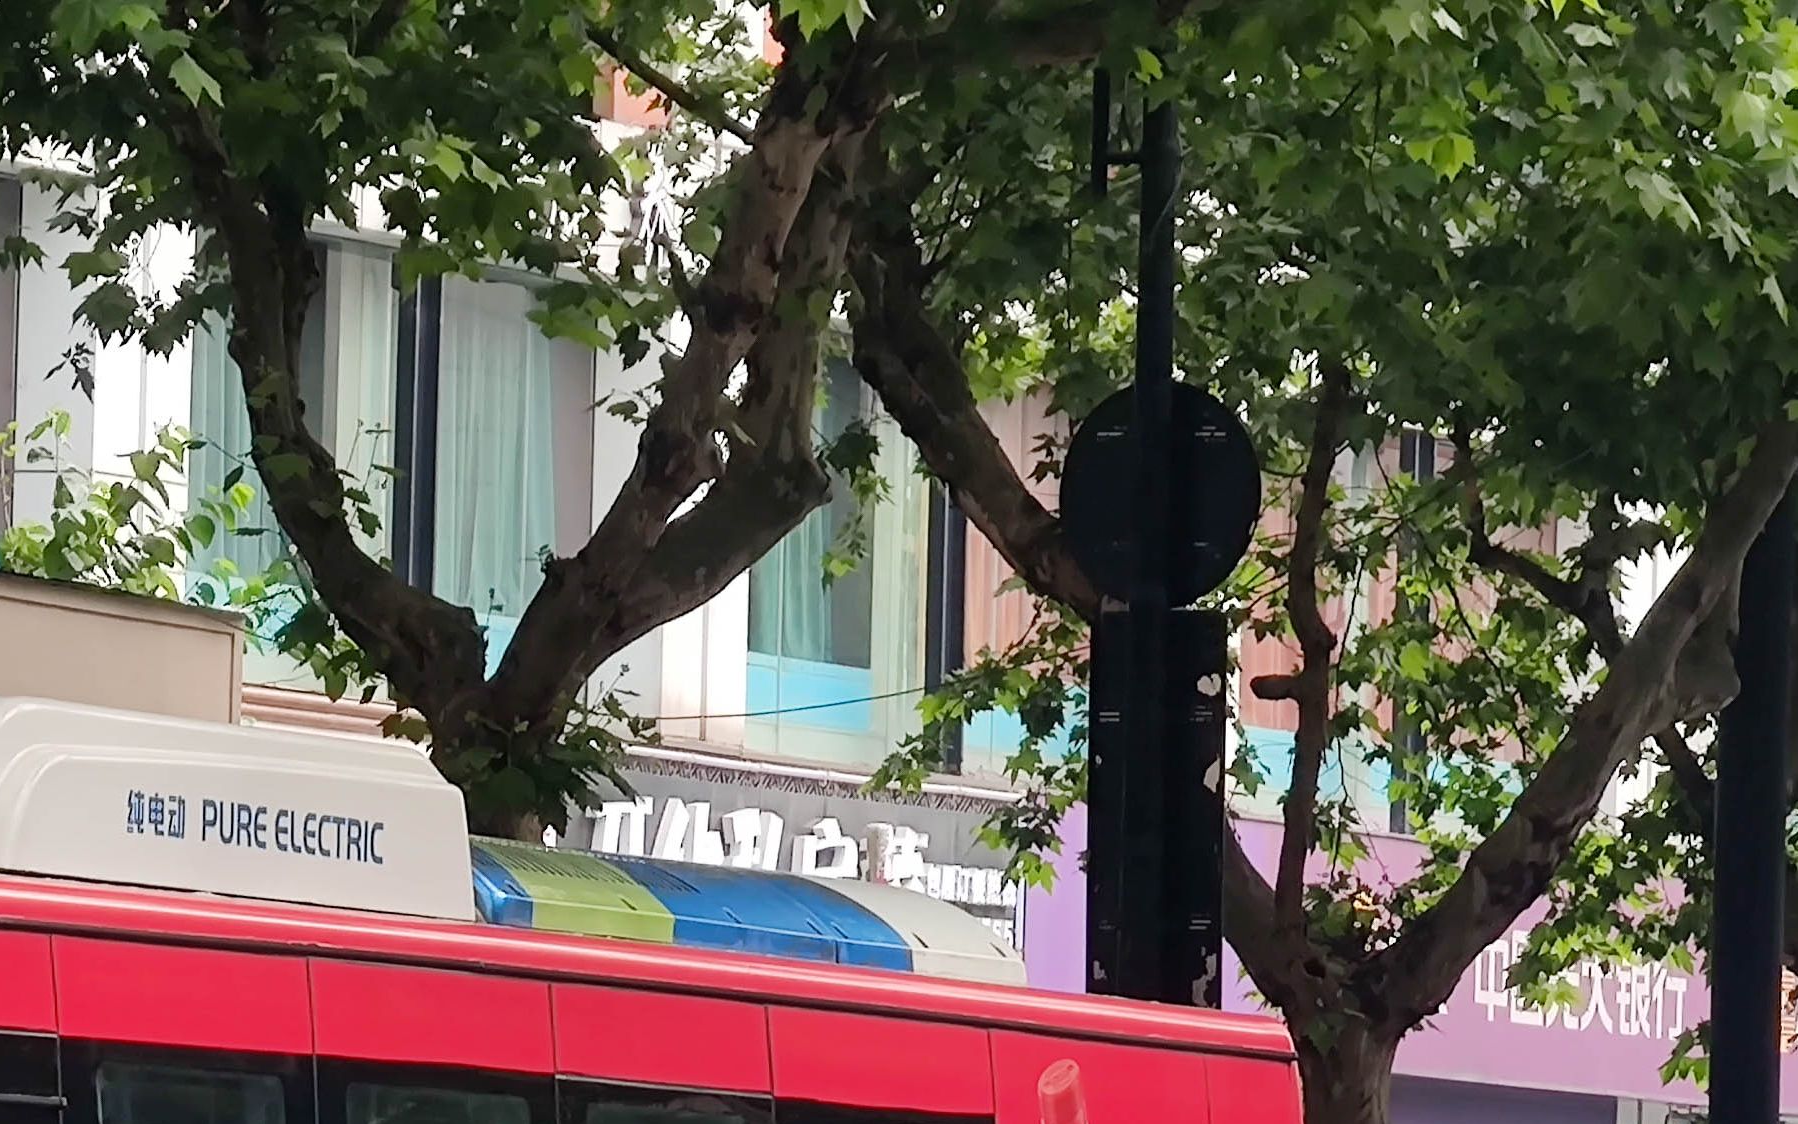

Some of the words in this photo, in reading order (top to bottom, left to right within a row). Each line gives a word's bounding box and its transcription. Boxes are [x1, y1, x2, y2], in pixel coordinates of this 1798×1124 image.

[126, 789, 186, 839] 纯电动
[202, 799, 267, 849] PURE
[274, 808, 384, 864] ELECTRIC
